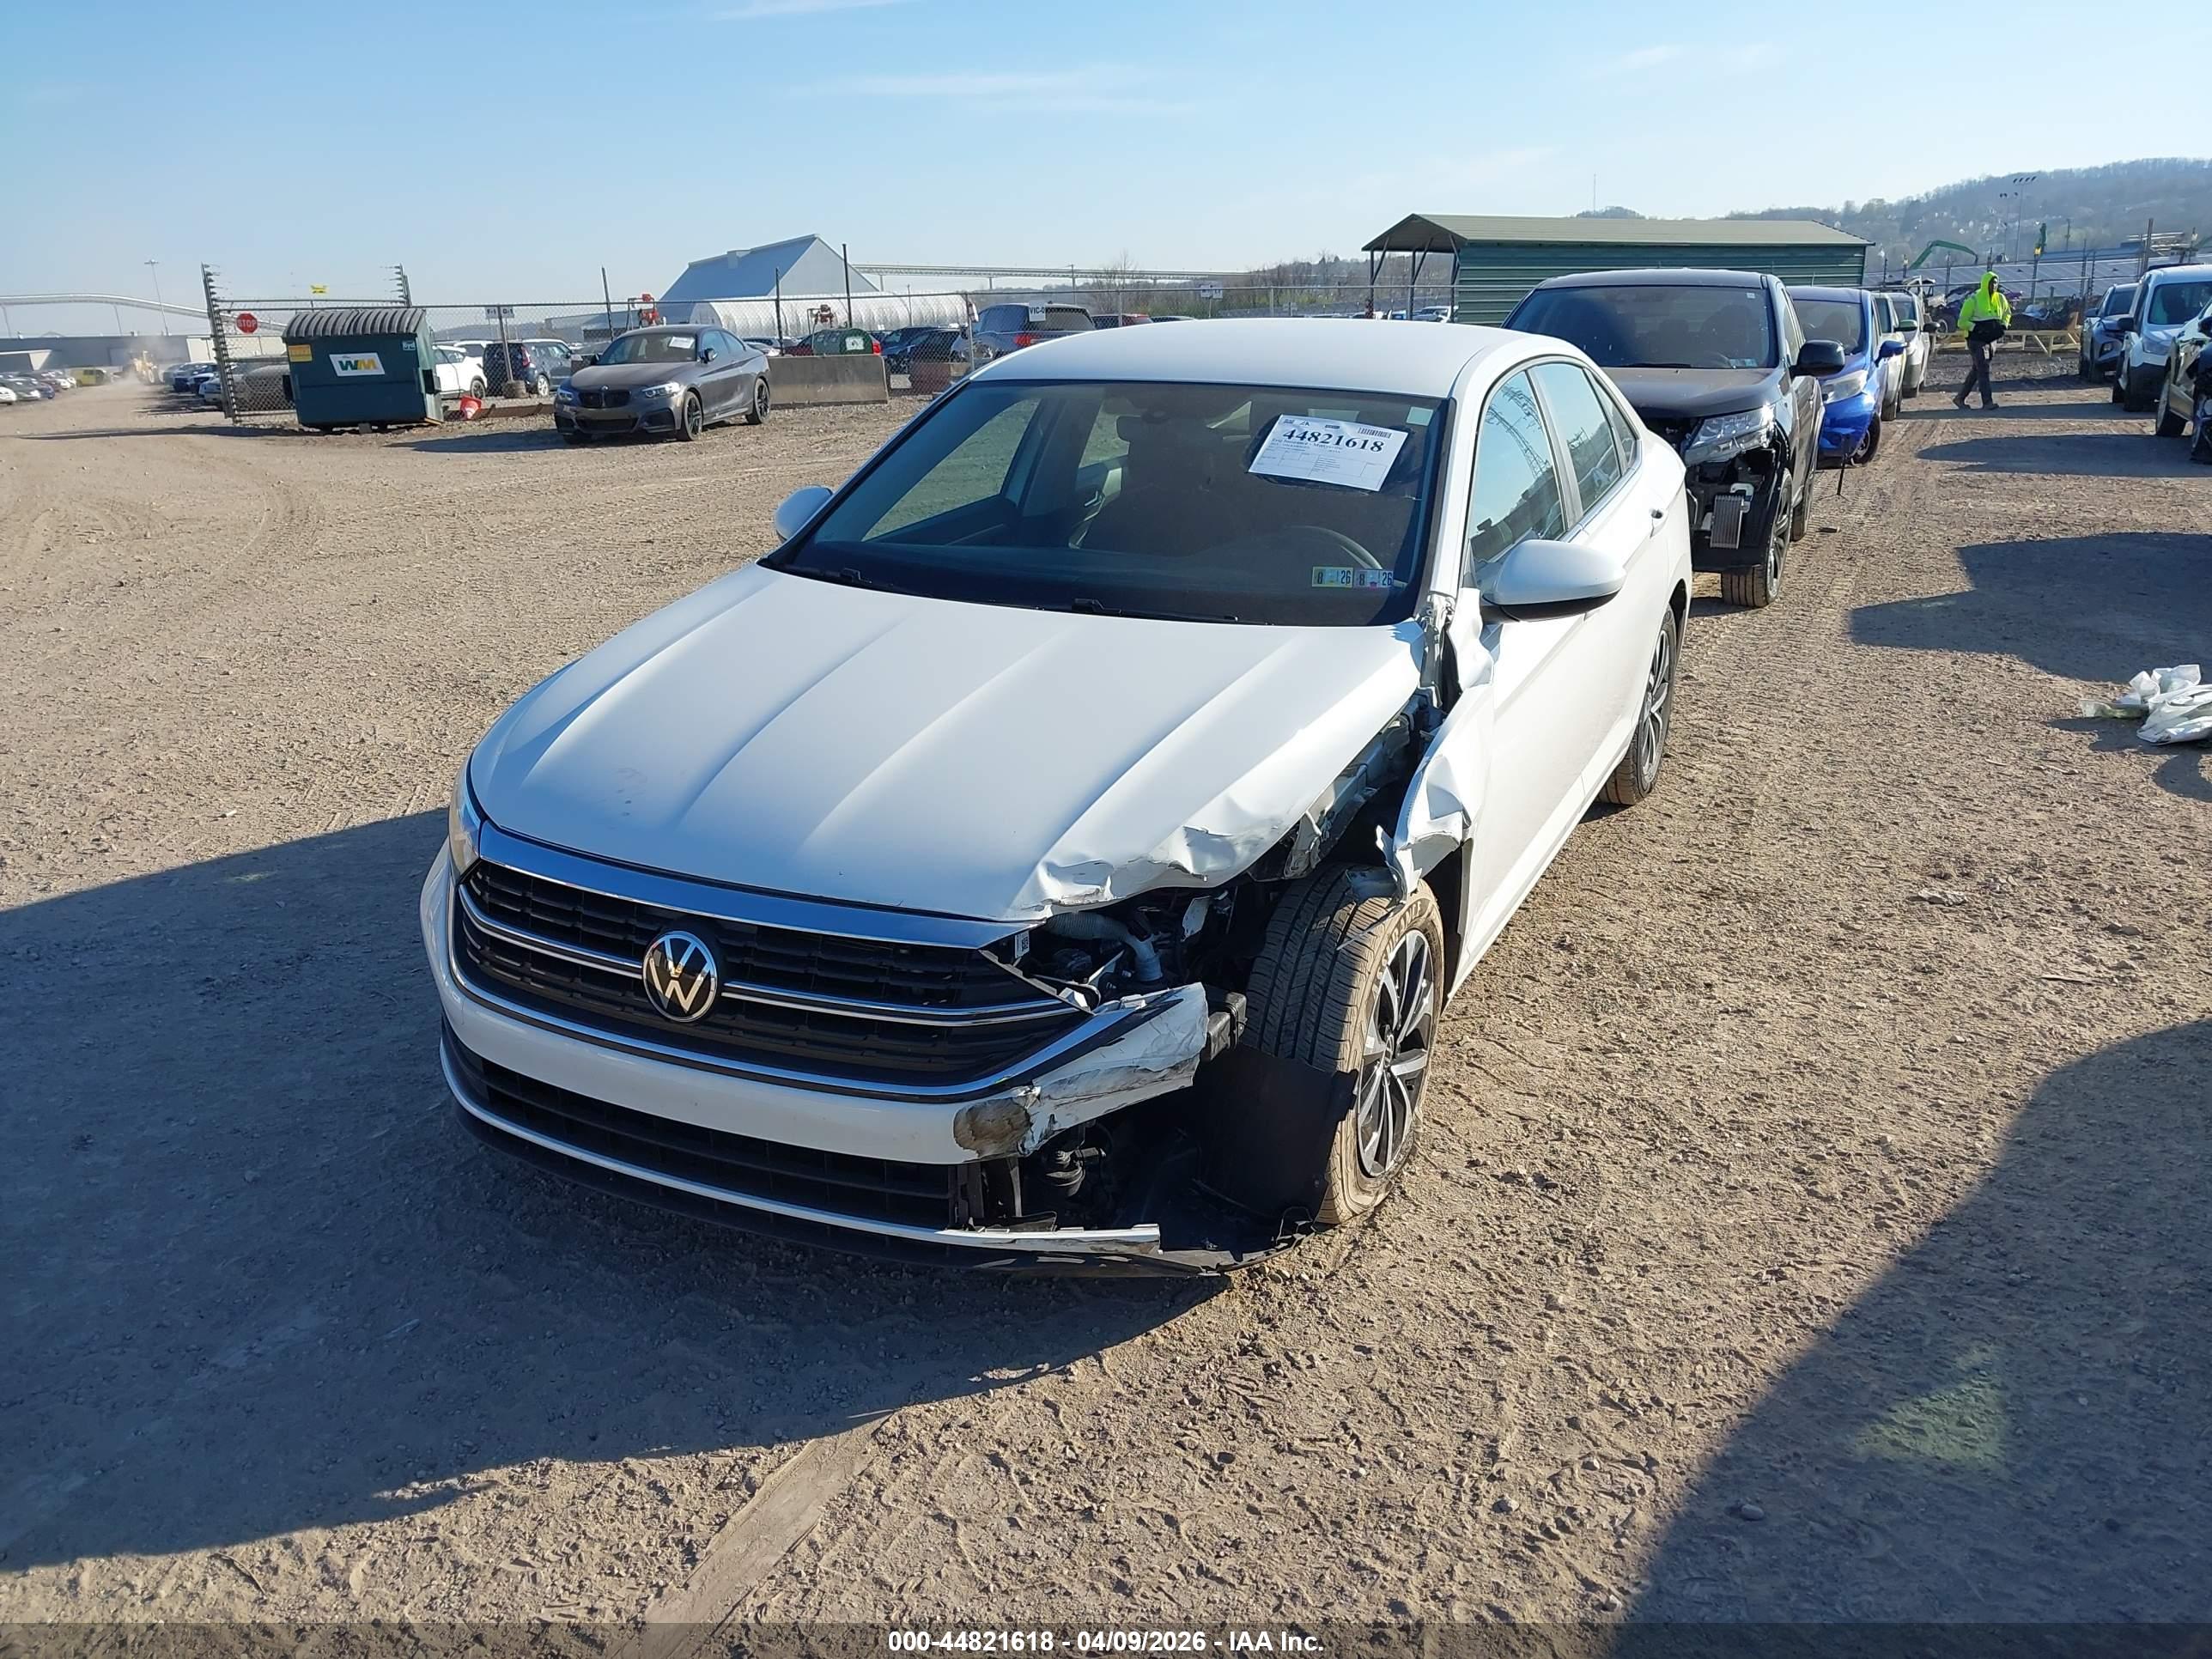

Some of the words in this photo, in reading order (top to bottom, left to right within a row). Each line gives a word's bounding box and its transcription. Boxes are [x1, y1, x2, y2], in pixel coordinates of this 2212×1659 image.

[238, 319, 257, 327] STOP
[338, 357, 378, 371] WM
[1283, 428, 1384, 453] 44821618
[1317, 572, 1324, 585] 8
[1340, 569, 1351, 584] 26
[1359, 573, 1365, 586] 8
[1382, 572, 1392, 586] 26
